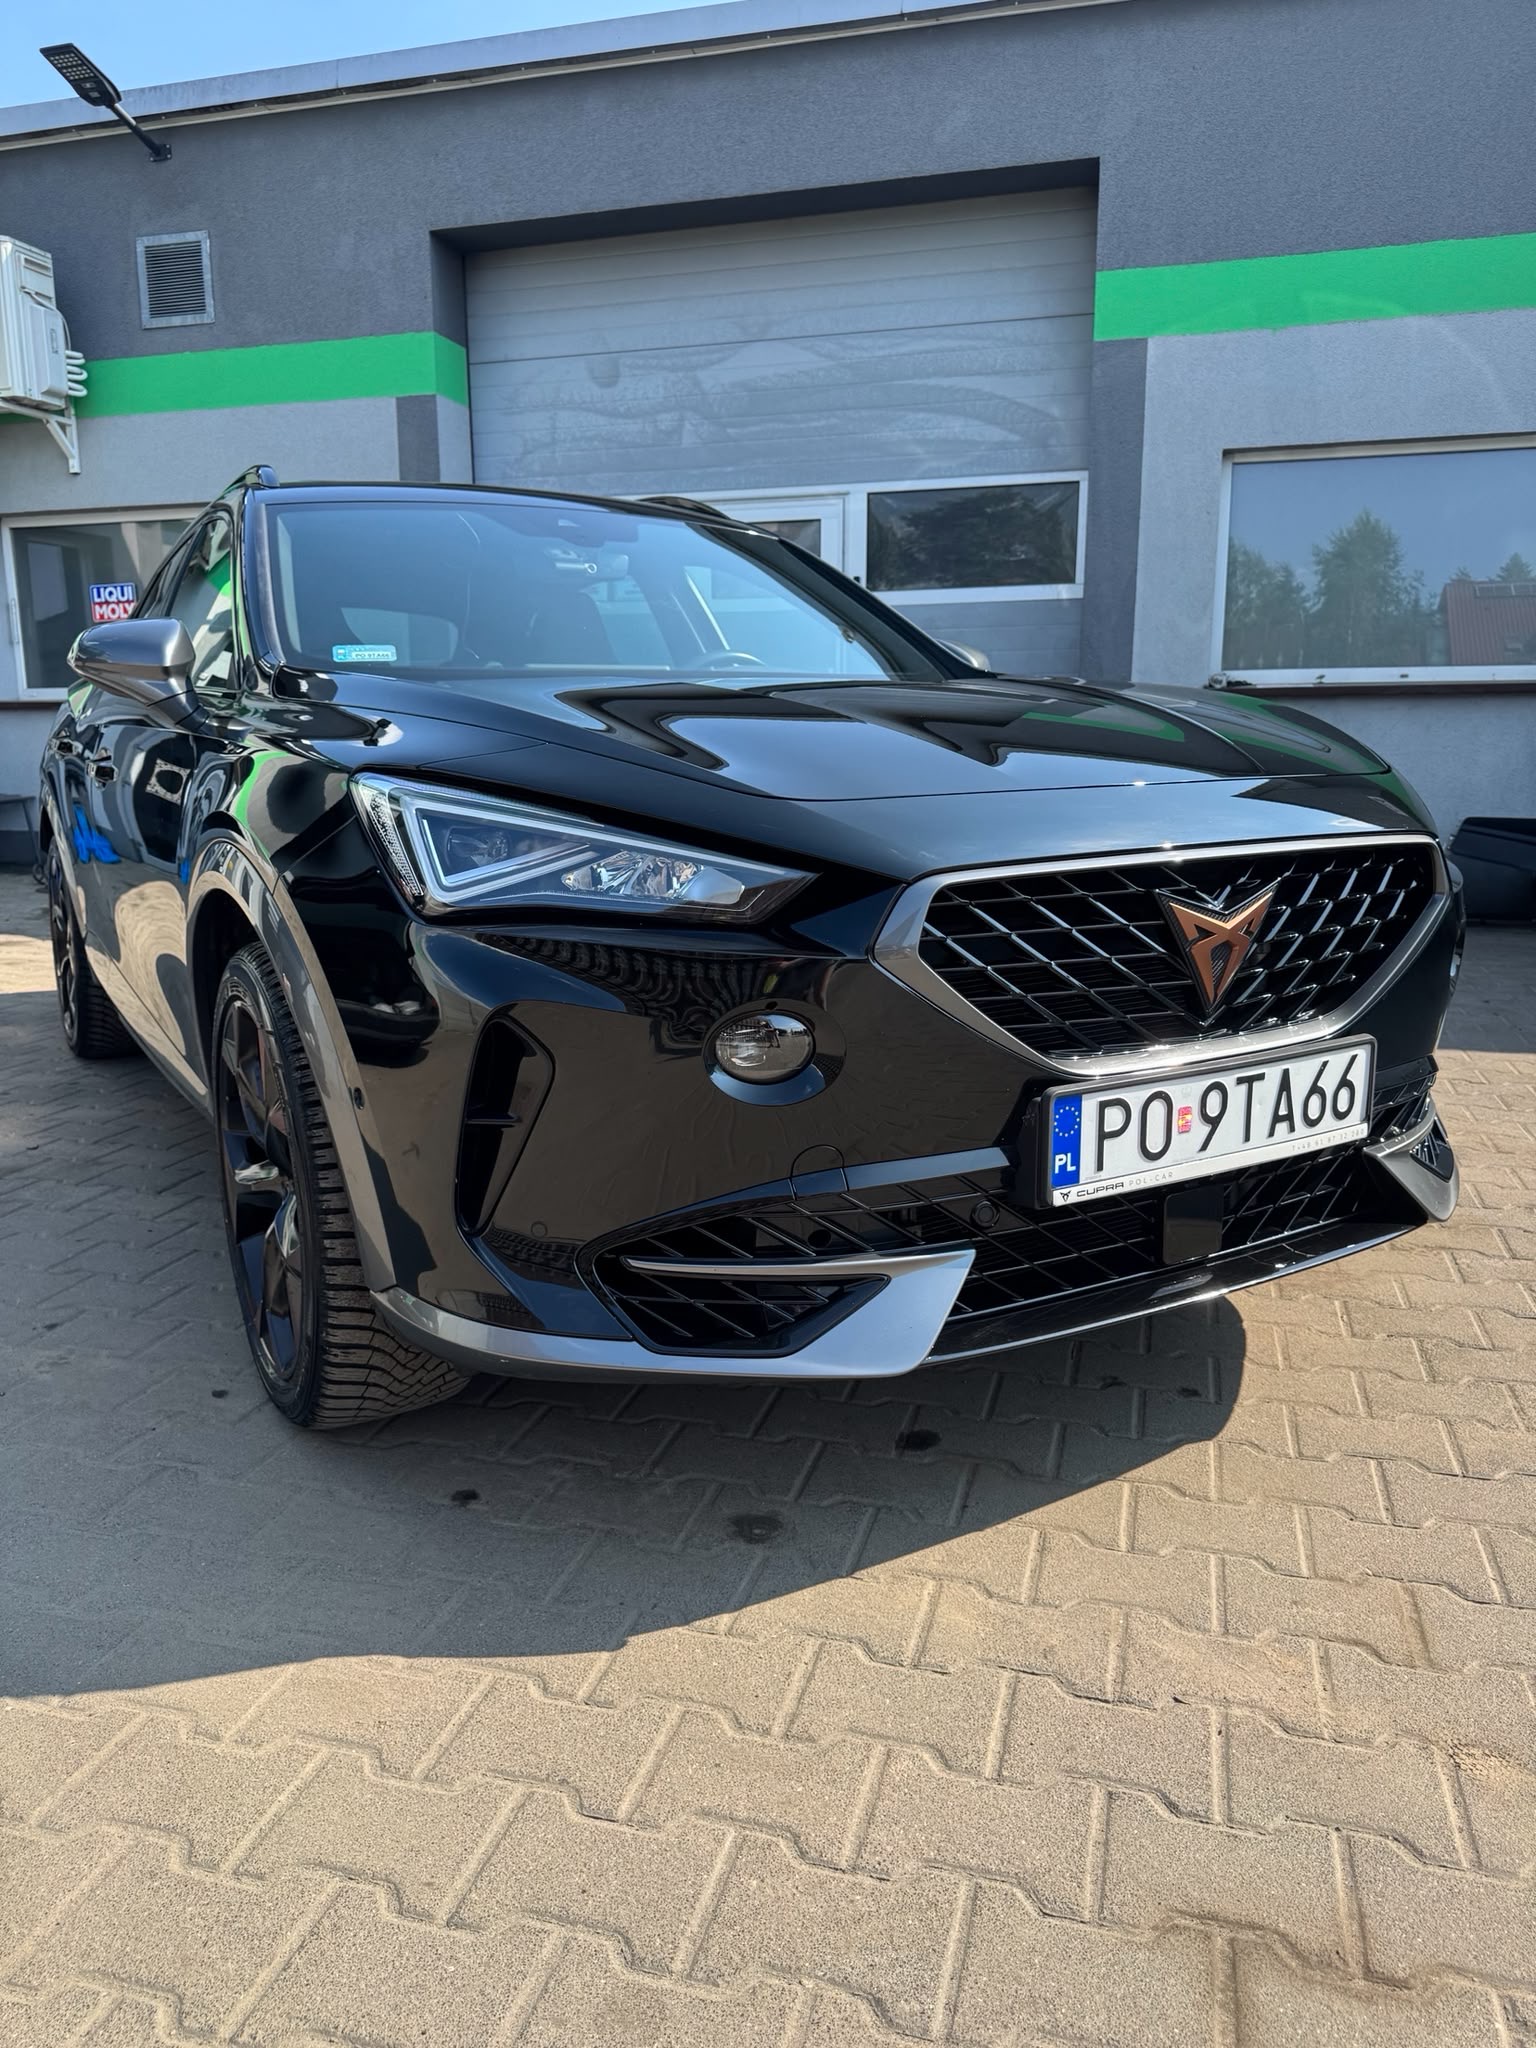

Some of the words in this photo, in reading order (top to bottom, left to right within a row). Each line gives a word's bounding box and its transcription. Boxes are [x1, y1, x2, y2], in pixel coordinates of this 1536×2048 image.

[92, 585, 133, 603] LIQUI
[95, 602, 135, 620] MOLY
[1197, 1053, 1359, 1153] 9TA66
[1054, 1152, 1077, 1175] PL
[1076, 1182, 1125, 1198] CUPRA
[1128, 1171, 1174, 1187] POL-CAR
